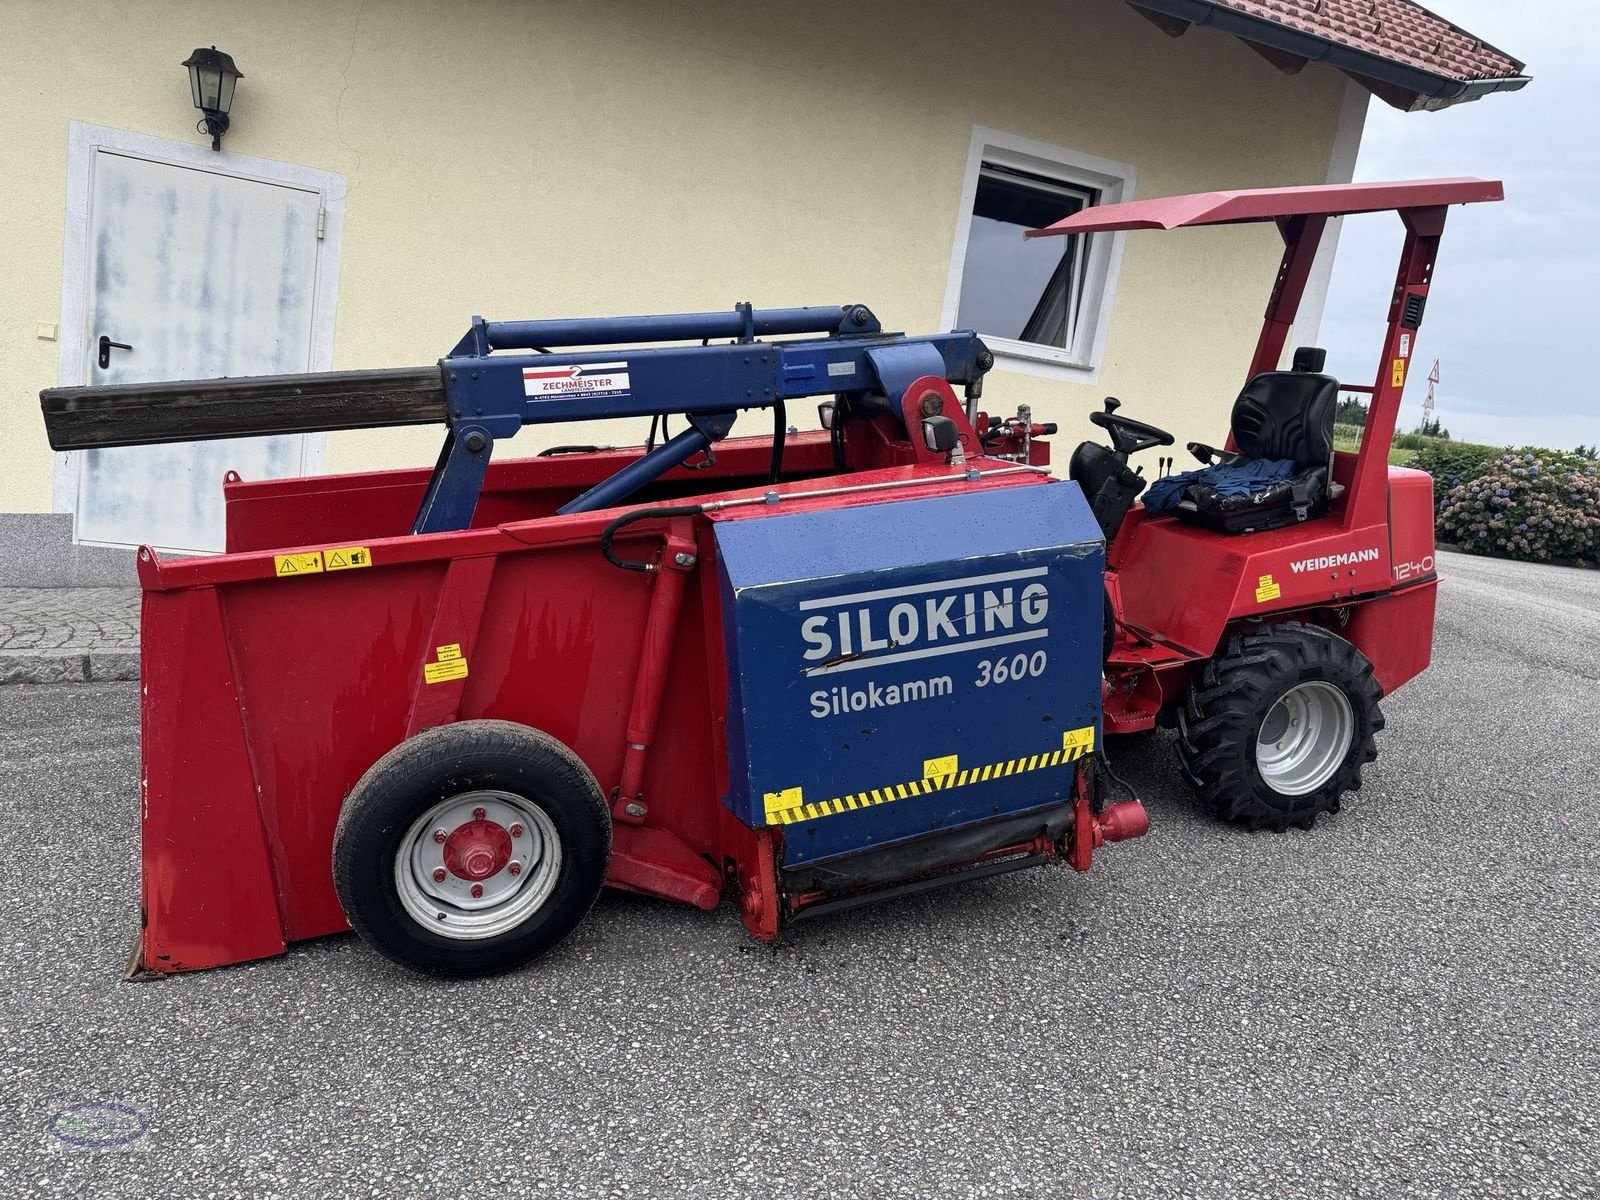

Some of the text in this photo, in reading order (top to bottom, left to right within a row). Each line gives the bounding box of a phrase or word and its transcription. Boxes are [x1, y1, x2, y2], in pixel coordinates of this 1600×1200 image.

[542, 378, 612, 391] ZECHMEISTER
[1290, 548, 1379, 574] WEIDEMANN
[1393, 555, 1434, 581] 1240
[801, 583, 1049, 661] SILOKING
[809, 650, 1047, 719] Silokamm 3600
